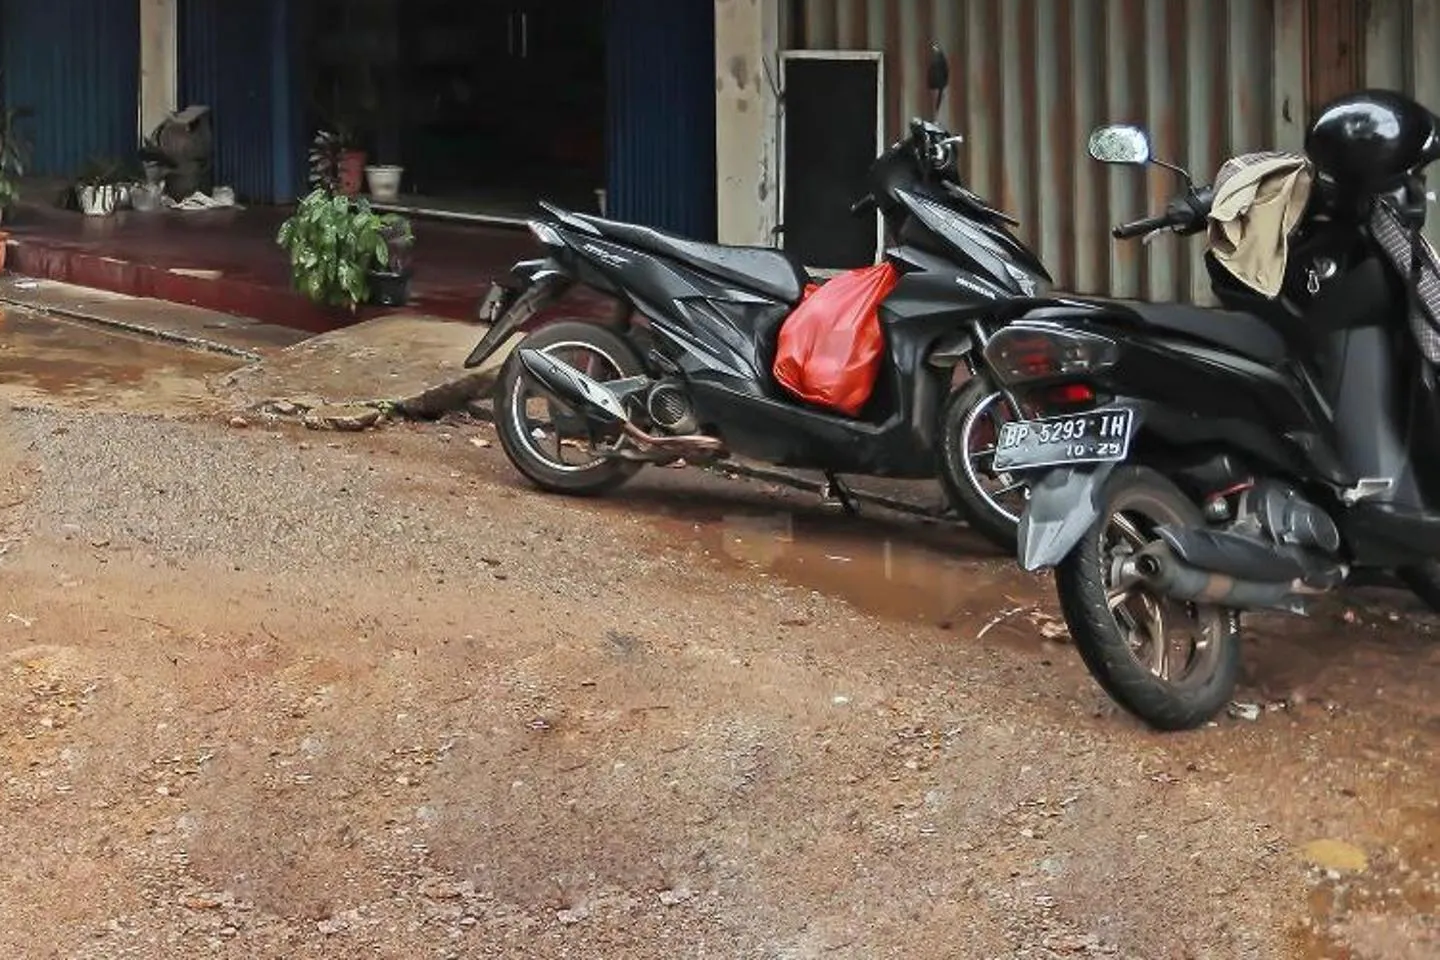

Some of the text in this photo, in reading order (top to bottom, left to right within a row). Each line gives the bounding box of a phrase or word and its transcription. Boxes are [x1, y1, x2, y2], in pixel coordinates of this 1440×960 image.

[1004, 415, 1125, 448] BP 5293 IH
